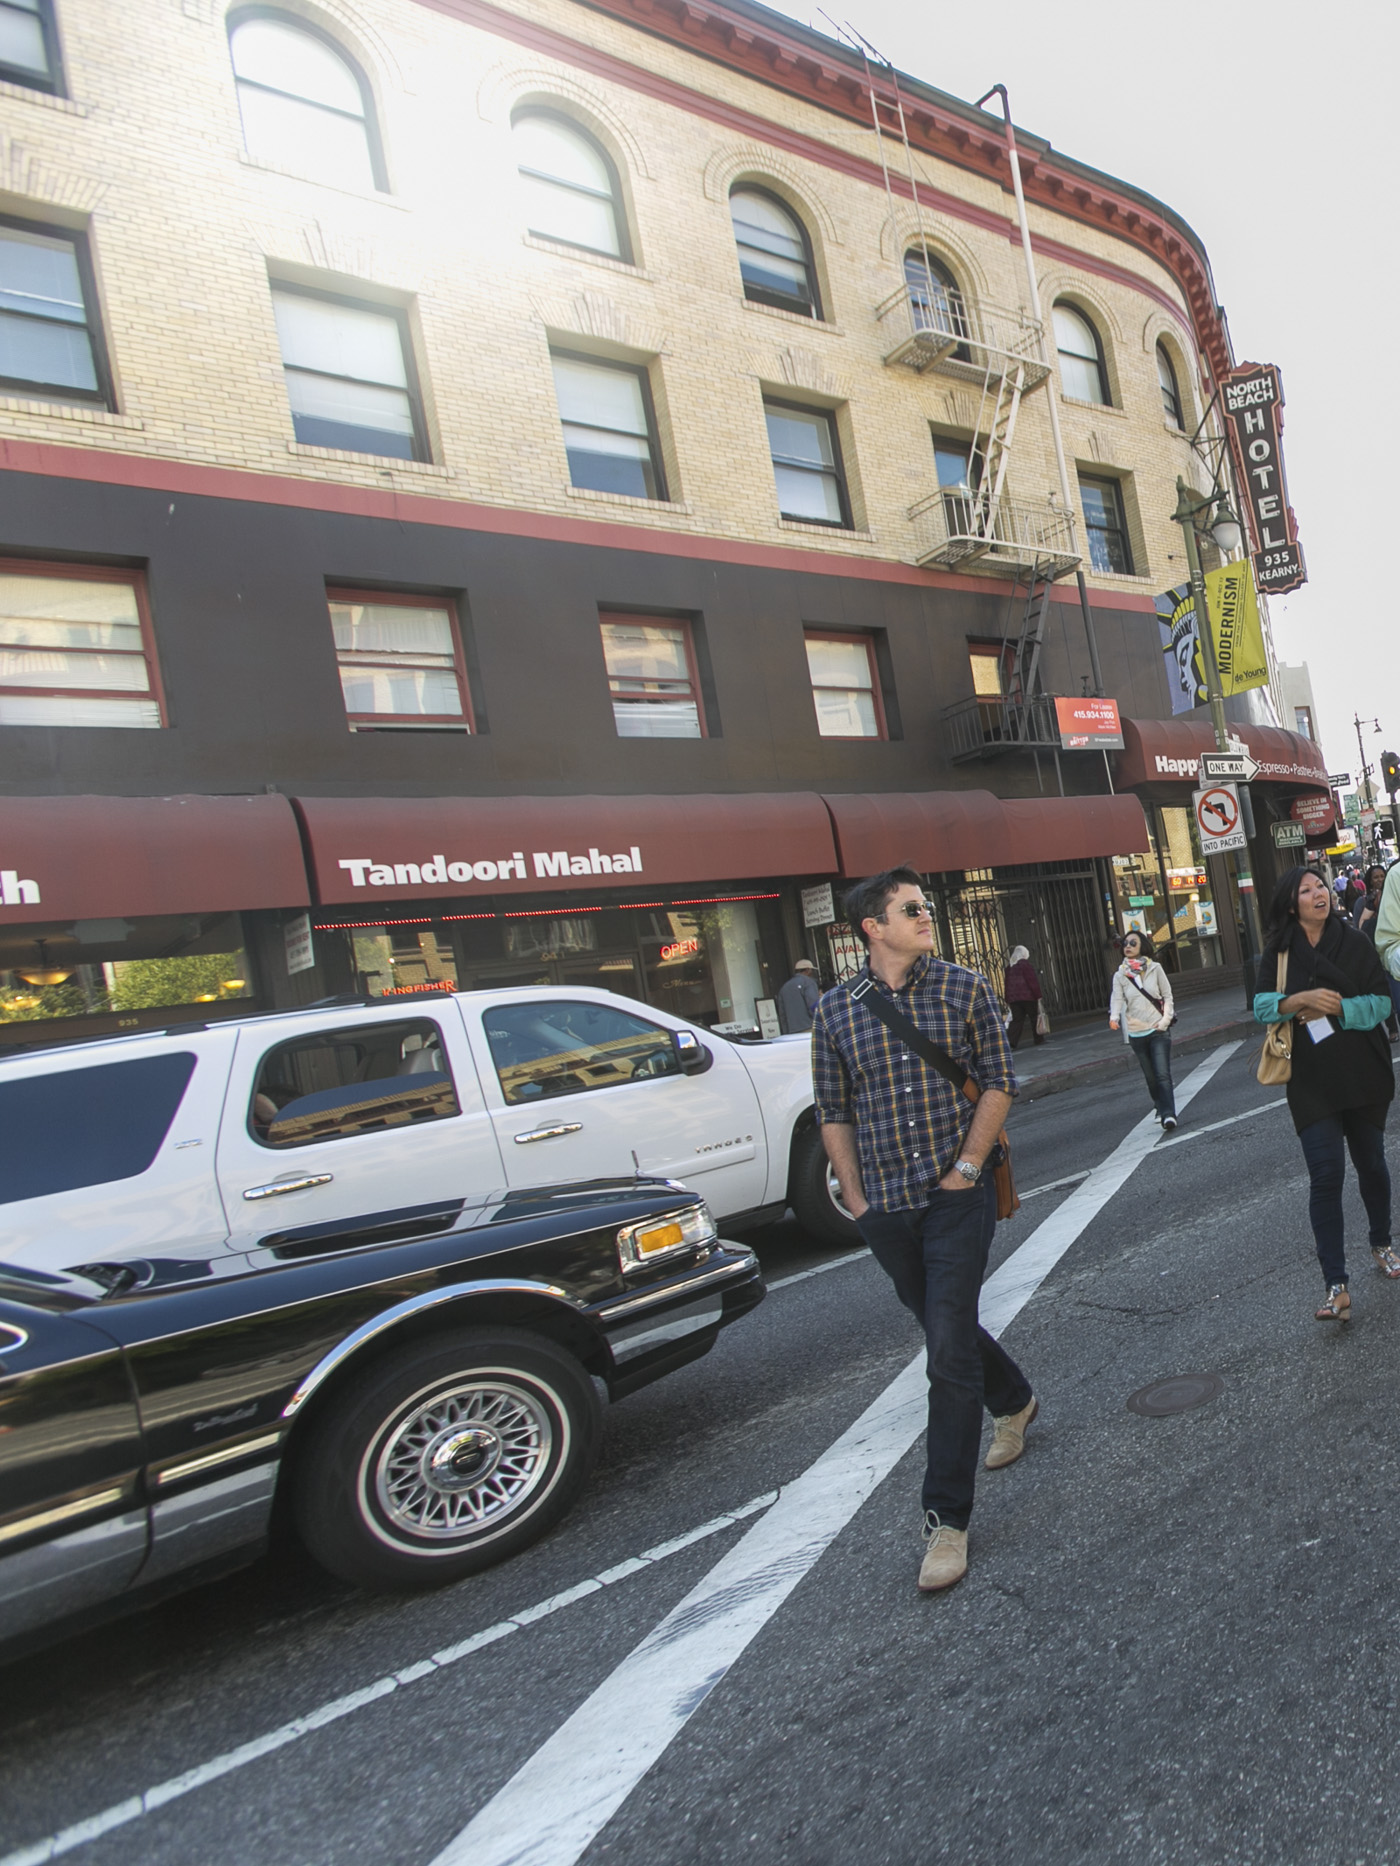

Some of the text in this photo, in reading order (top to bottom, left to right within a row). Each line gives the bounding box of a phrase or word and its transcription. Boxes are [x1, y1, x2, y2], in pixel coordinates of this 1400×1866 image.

[1226, 376, 1272, 398] NORTH
[1229, 388, 1274, 410] BEACH
[1244, 408, 1285, 549] HOTEL
[1264, 551, 1290, 567] 935
[1258, 563, 1299, 582] KEARNY
[1218, 577, 1239, 675] MODERNISM
[1235, 667, 1267, 683] de Young
[1073, 710, 1115, 719] 415.934.1100
[1155, 755, 1200, 777] Happ
[1258, 759, 1290, 775] Espresso
[1209, 762, 1244, 773] ONE WAY
[1276, 825, 1303, 839] ATM
[1203, 835, 1245, 851] INTO PACIFIC
[338, 847, 643, 887] Tandoori Mahal
[0, 870, 41, 905] h
[660, 939, 698, 961] OPEN
[382, 980, 458, 996] KINGFISHER
[118, 1018, 139, 1027] 935
